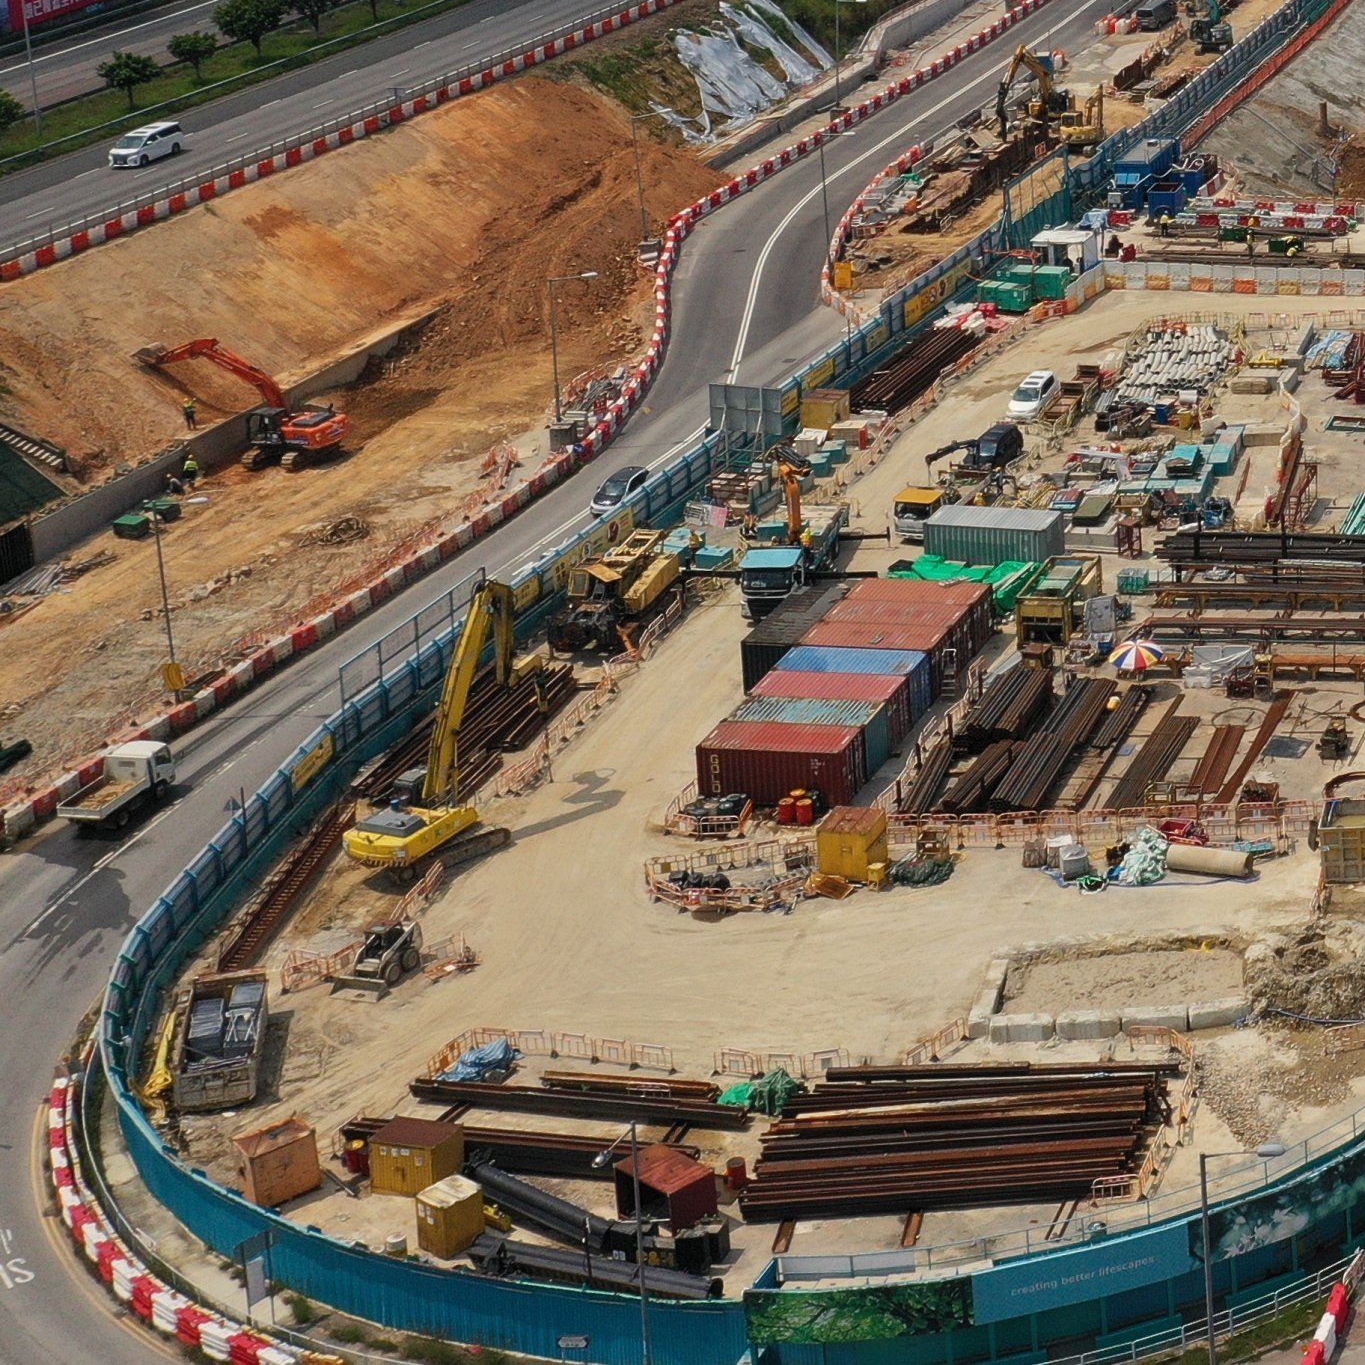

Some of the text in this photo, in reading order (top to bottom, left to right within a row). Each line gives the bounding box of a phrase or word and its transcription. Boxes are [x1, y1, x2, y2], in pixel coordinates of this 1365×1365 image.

[710, 754, 722, 793] GOLD
[1011, 1255, 1155, 1296] creating better lifescapes
